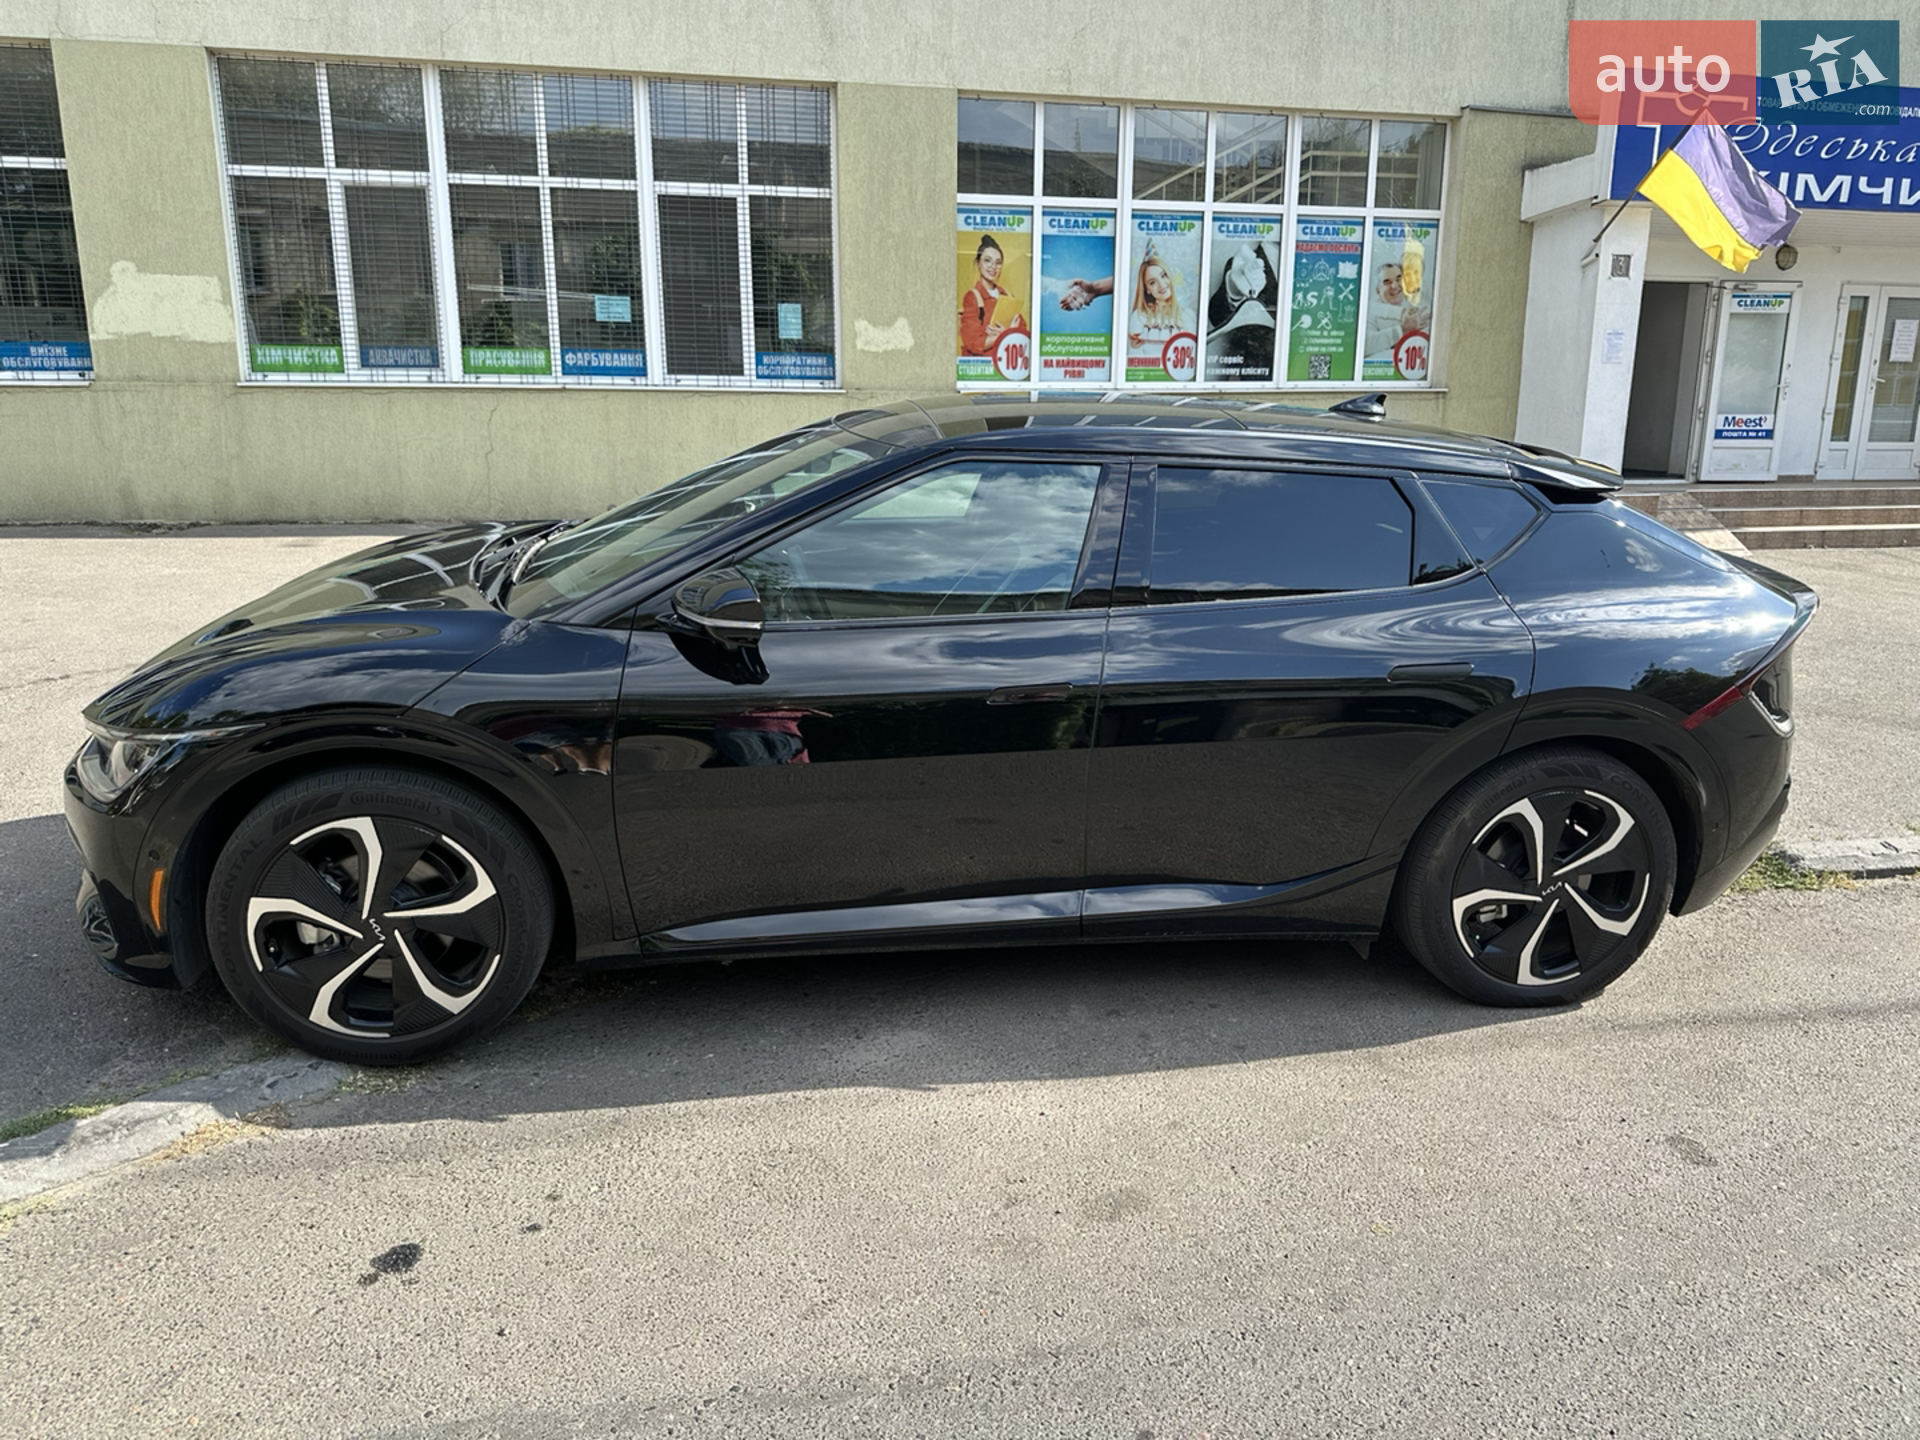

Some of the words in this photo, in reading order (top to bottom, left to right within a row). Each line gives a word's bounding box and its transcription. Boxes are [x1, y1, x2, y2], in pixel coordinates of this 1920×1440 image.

[964, 215, 1025, 228] CLEANUP
[1048, 217, 1108, 230] CLEANUP
[1137, 220, 1195, 233] CLEANUP
[1218, 223, 1274, 235] CLEANUP
[1301, 225, 1357, 237] CLEANUP
[1737, 299, 1784, 308] CLEANUP
[256, 347, 340, 366] ХІМЧИСТКА
[368, 349, 433, 366] АКВАЧИСТКА
[469, 350, 546, 368] ПРАСУВАННЯ
[565, 352, 644, 367] ФАРБУВАННЯ
[1722, 415, 1764, 428] Meest
[349, 790, 432, 814] Continental
[217, 837, 265, 989] CONTINENTAL
